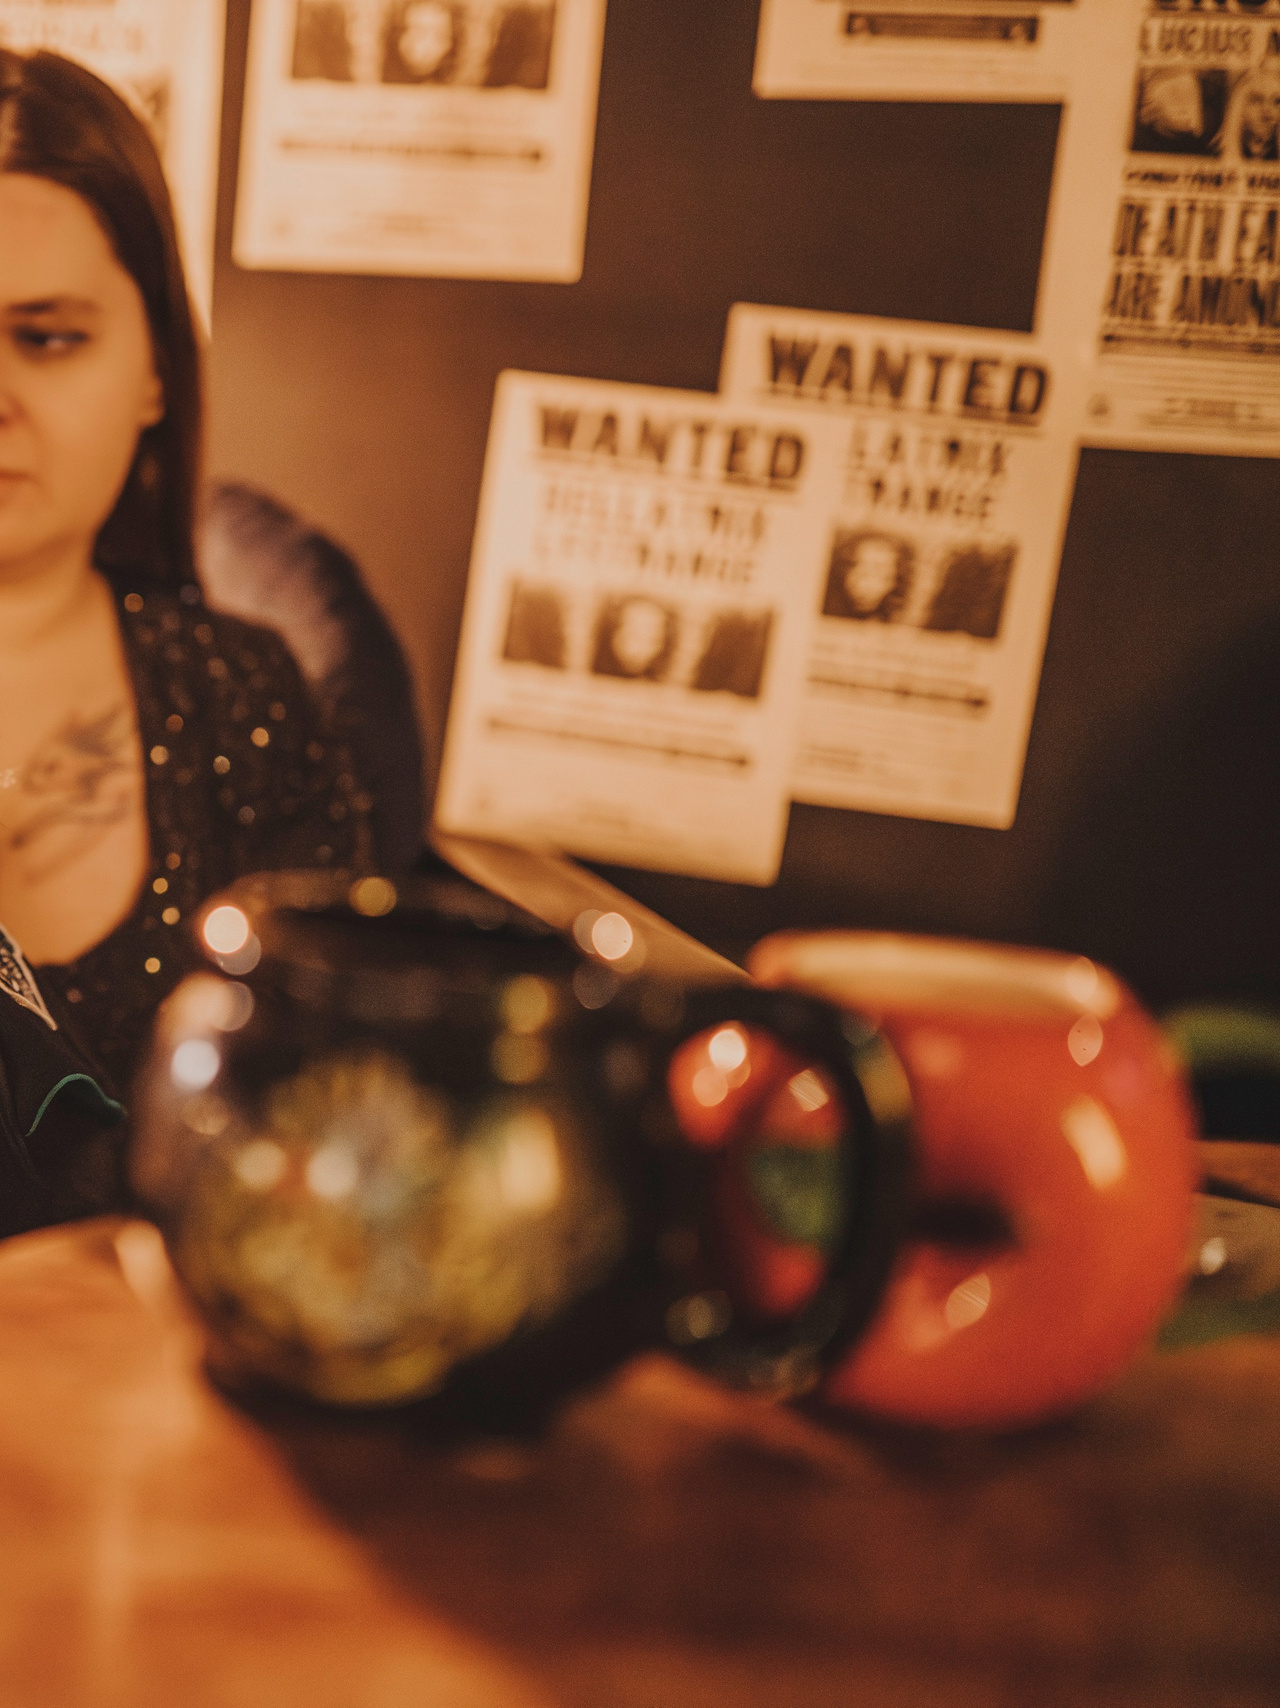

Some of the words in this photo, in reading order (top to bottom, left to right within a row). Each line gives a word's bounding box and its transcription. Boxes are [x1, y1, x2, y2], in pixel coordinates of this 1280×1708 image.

[1136, 22, 1251, 54] LUCIUS
[768, 335, 1048, 420] WANTED
[539, 404, 807, 486] WANTED
